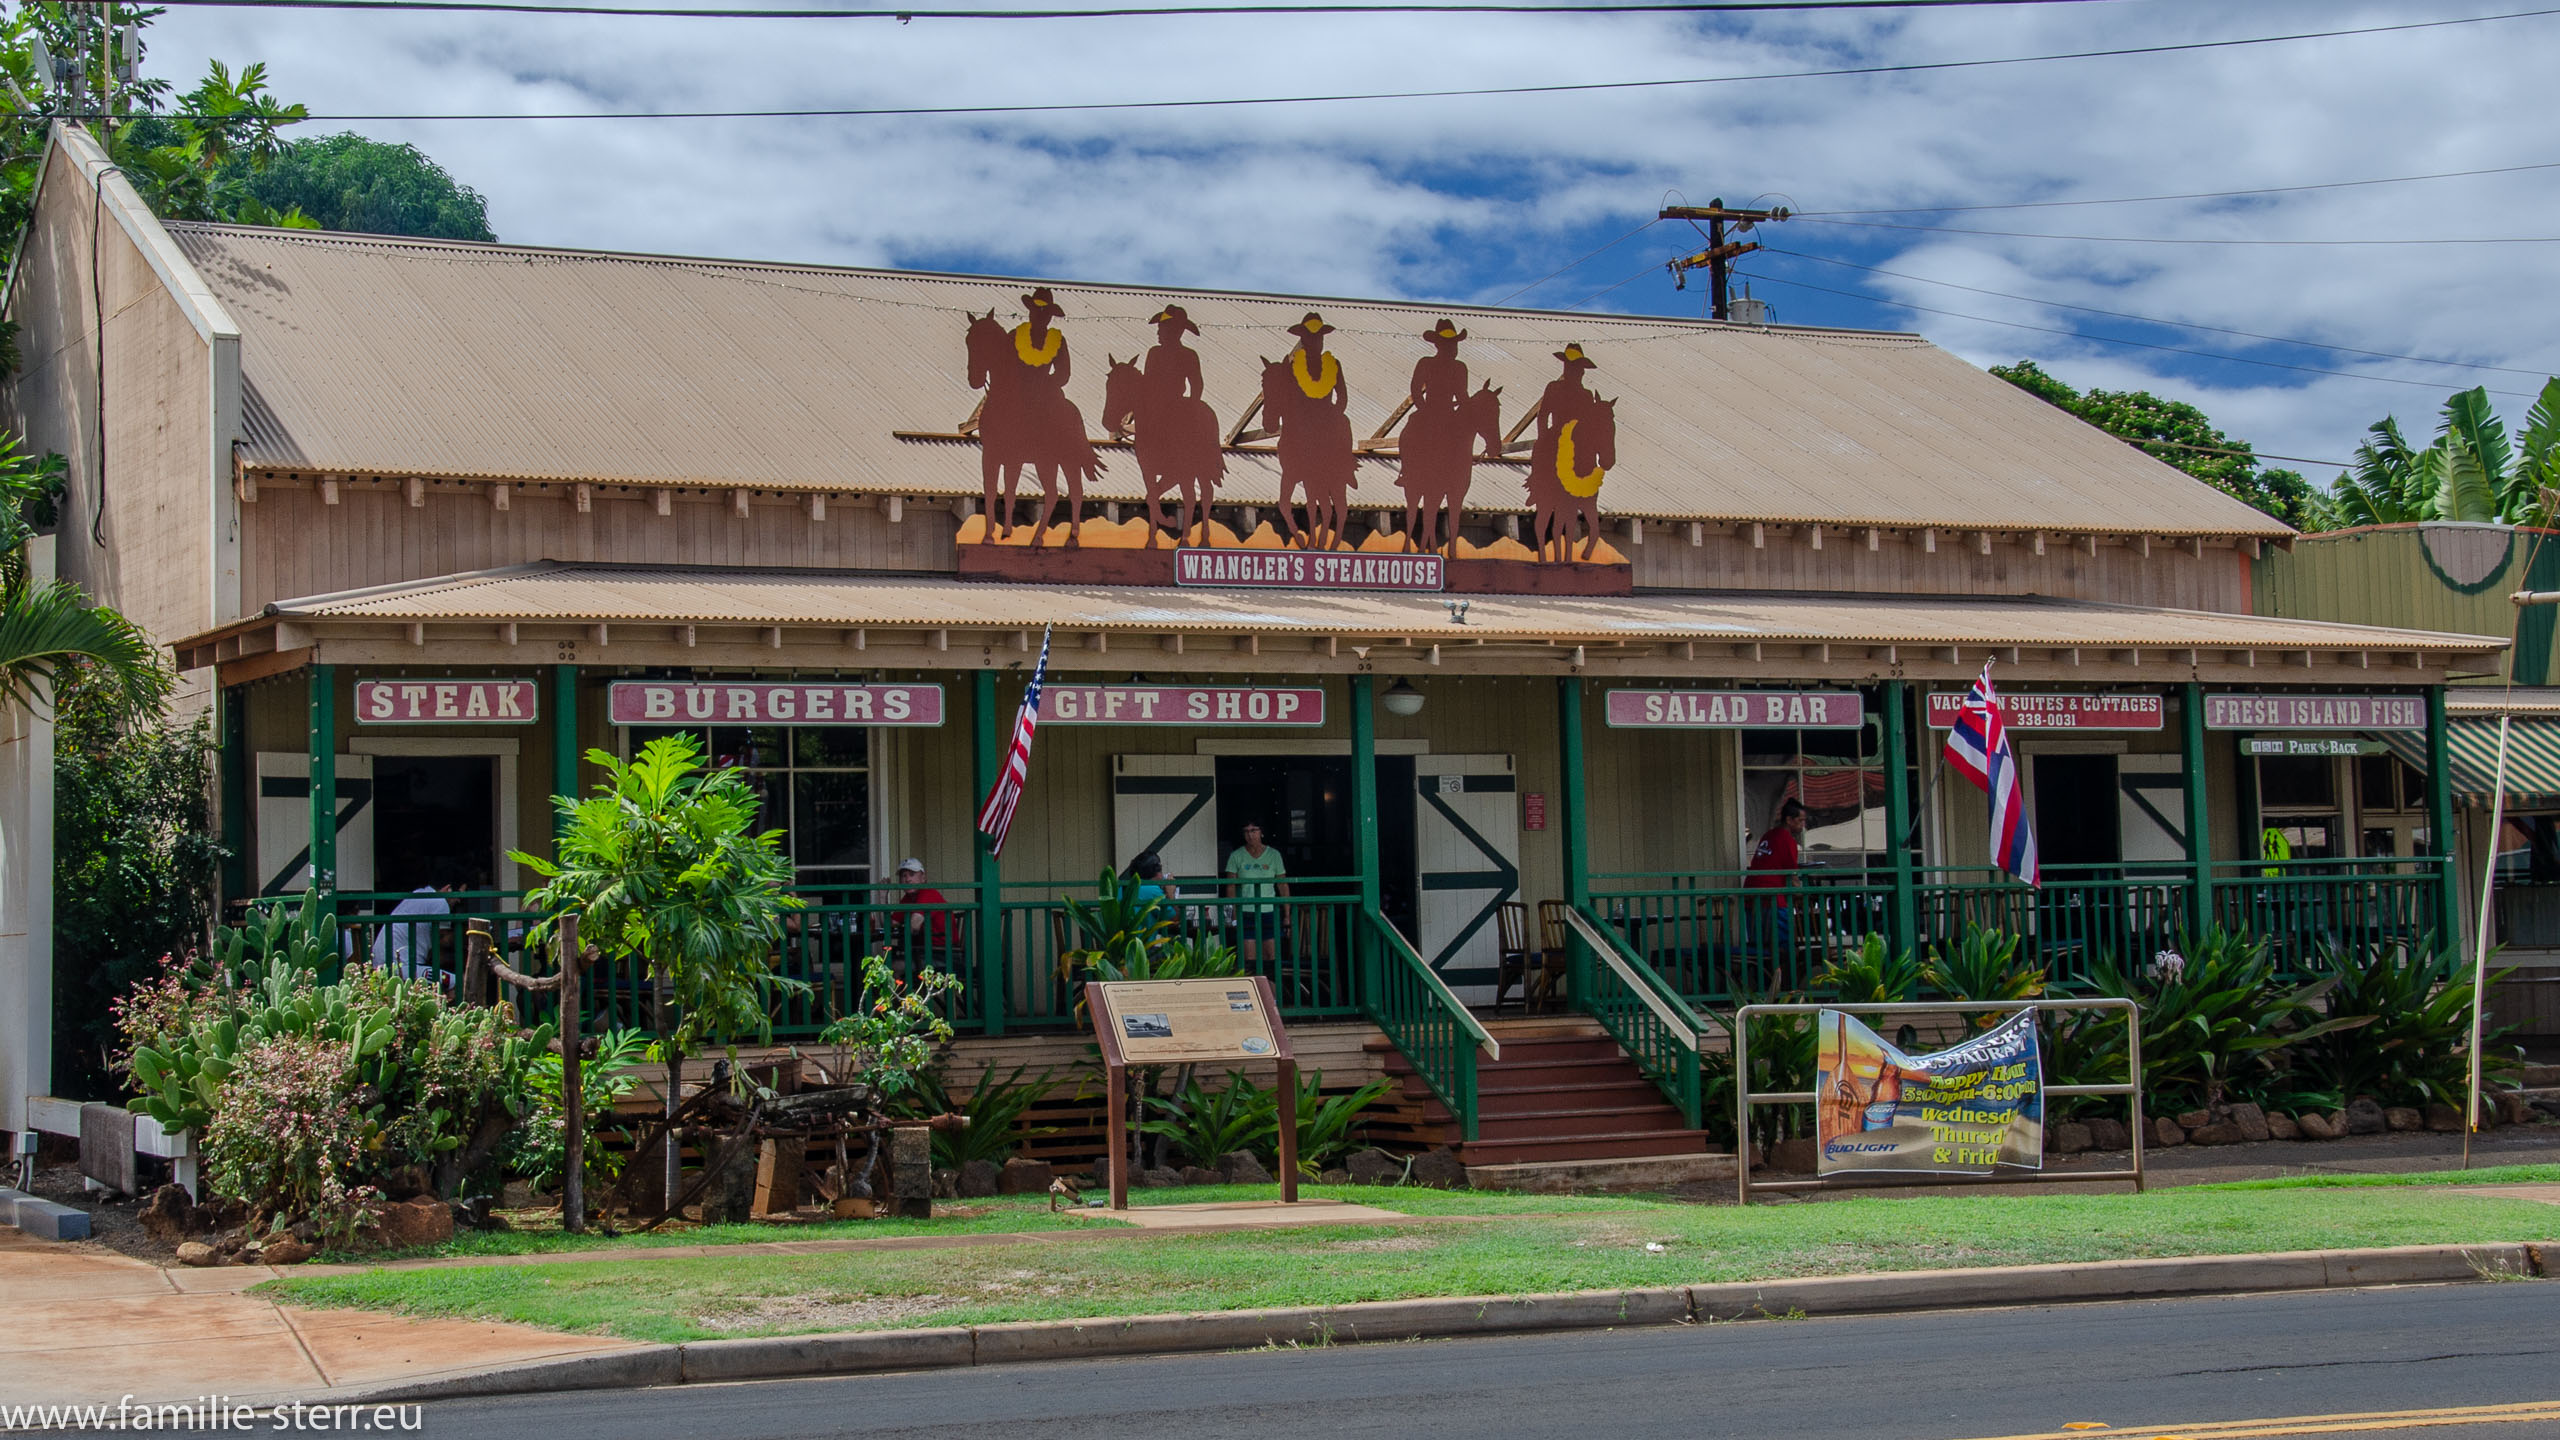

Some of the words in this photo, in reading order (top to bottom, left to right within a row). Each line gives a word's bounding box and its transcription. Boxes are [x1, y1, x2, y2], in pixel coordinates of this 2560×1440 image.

[1183, 554, 1304, 582] WRANGLER'S
[1314, 557, 1437, 585] STEAKHOUSE
[371, 685, 521, 718] STEAK
[644, 687, 911, 719] BURGERS
[1055, 690, 1159, 719] GIFT
[1188, 692, 1299, 720] SHOP
[1645, 695, 1748, 723] SALAD
[1766, 696, 1827, 723] BAR
[1932, 695, 2005, 711] VACN
[2010, 696, 2064, 711] SUITES
[2069, 697, 2078, 711] &
[2082, 697, 2157, 712] COTTAGES
[2017, 713, 2076, 726] 338-0031
[2215, 700, 2279, 724] FRESH
[2290, 700, 2361, 725] ISLAND
[2371, 701, 2415, 725] FISH
[1929, 1070, 1988, 1091] Happy
[1921, 1106, 2019, 1124] Wednesd
[1929, 1126, 2006, 1144] Thursd
[1827, 1144, 1855, 1154] BUD
[1855, 1142, 1899, 1152] LIGHT
[1932, 1147, 1952, 1163] &
[1957, 1147, 2000, 1165] Frid
